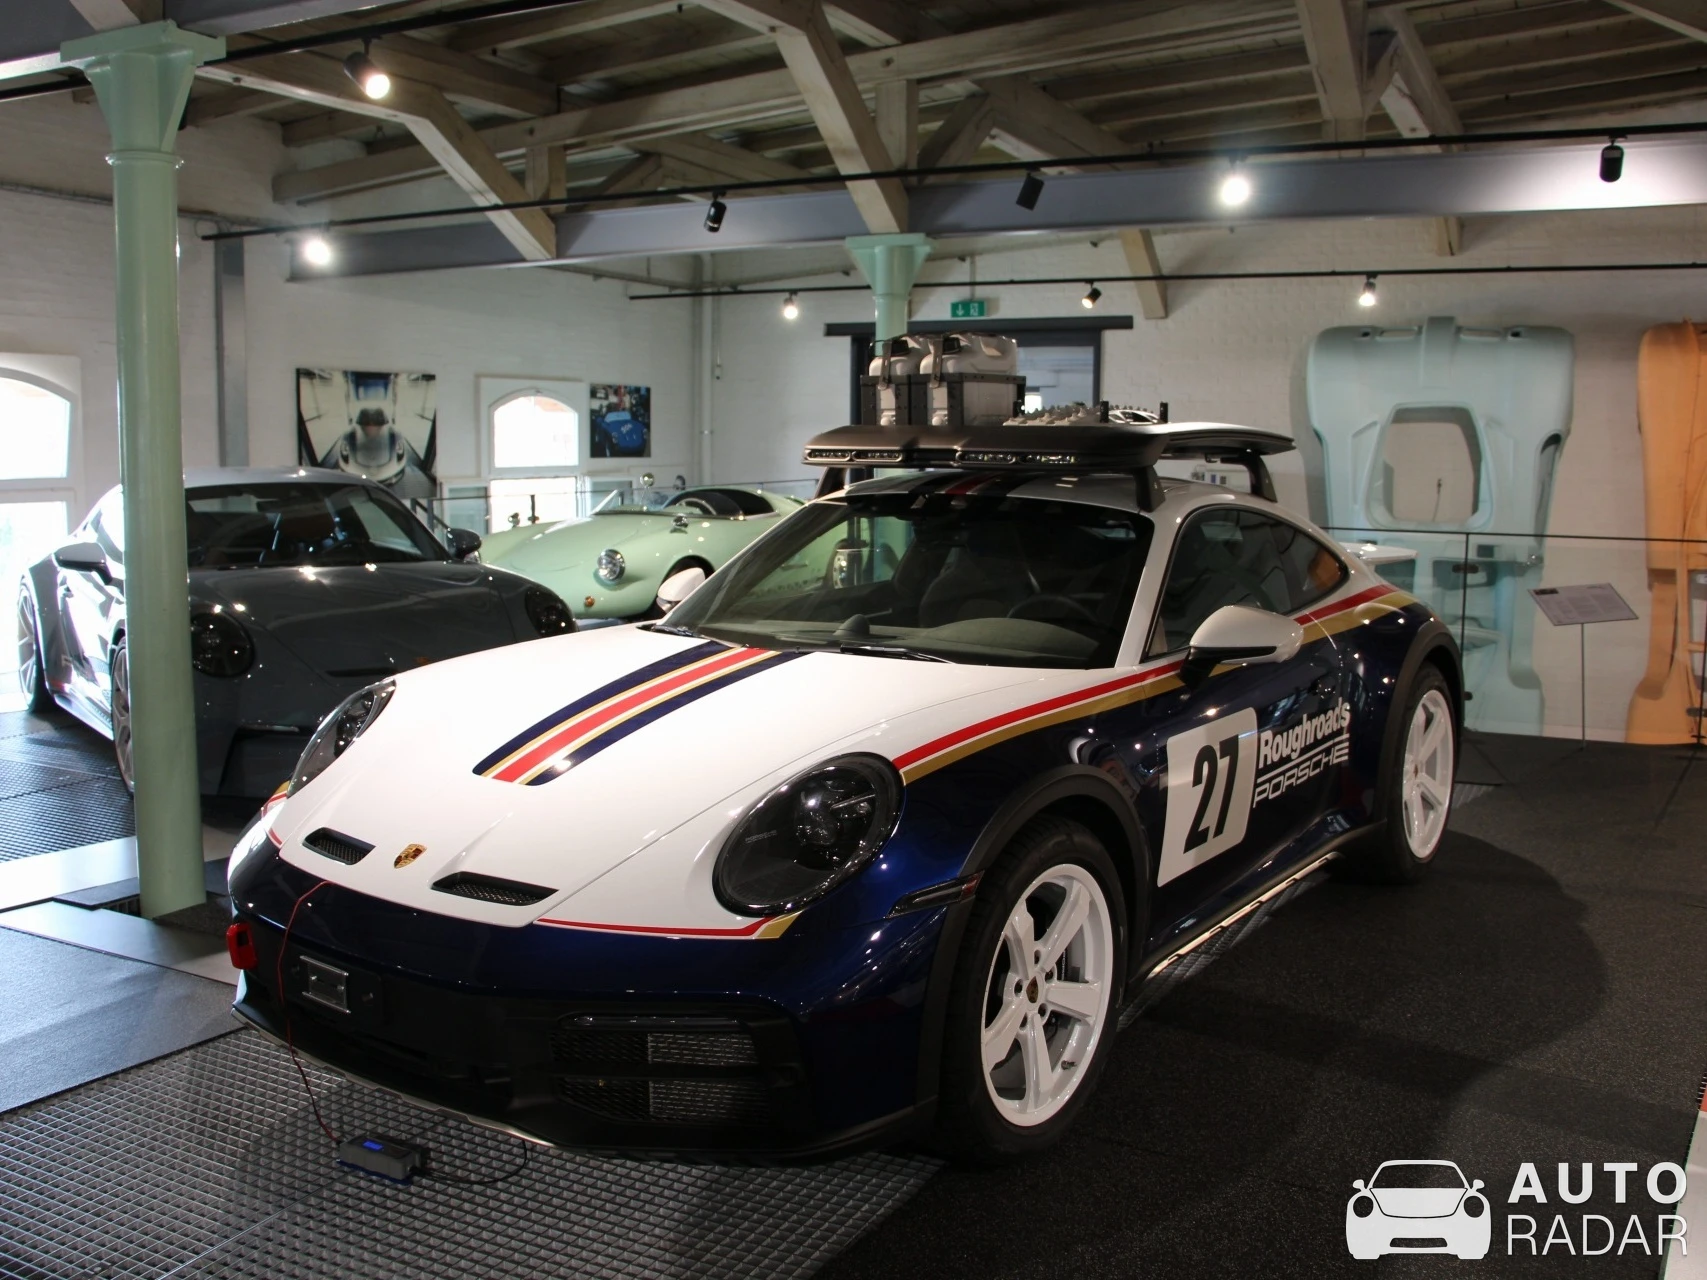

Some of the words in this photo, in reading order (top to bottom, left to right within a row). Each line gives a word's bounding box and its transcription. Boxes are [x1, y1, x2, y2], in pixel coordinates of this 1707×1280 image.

[1259, 697, 1350, 769] Roughroads
[1184, 734, 1239, 855] 27
[1253, 741, 1349, 809] PORSCHE
